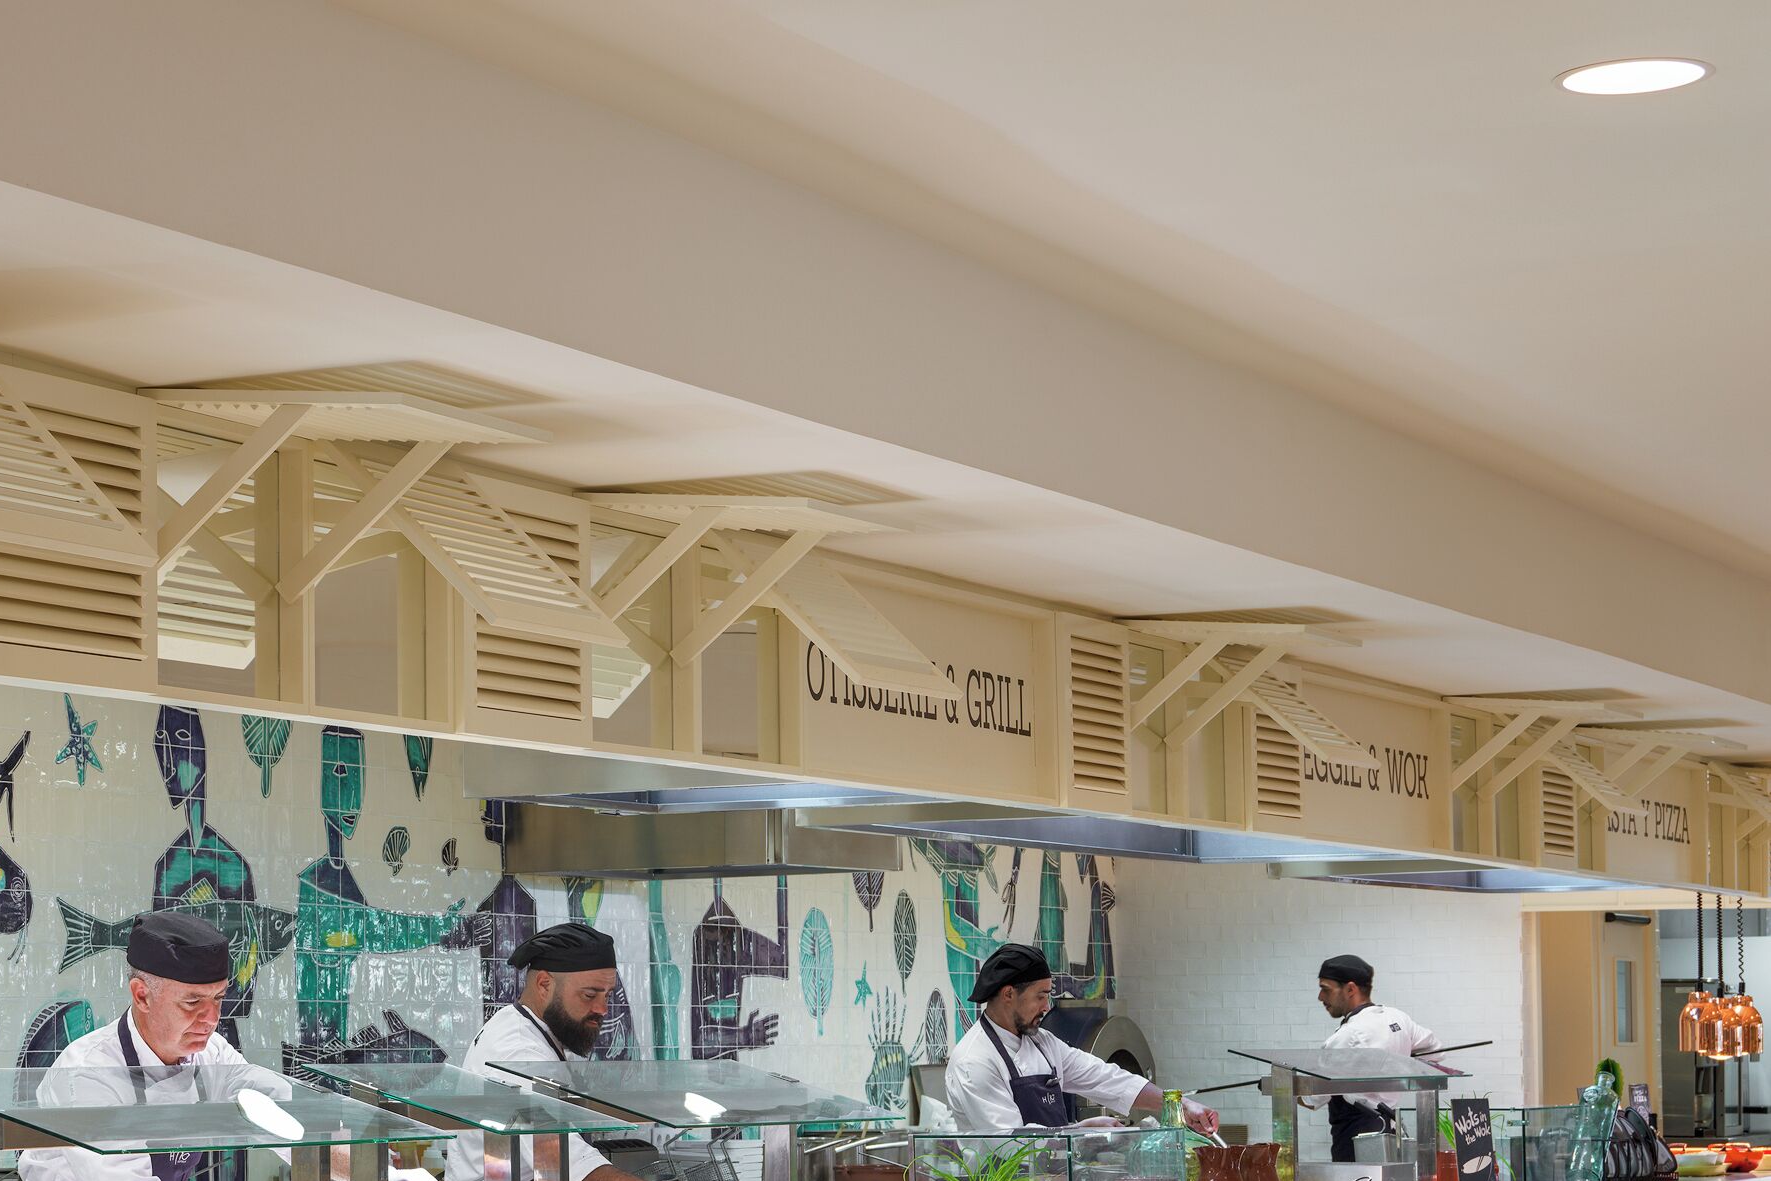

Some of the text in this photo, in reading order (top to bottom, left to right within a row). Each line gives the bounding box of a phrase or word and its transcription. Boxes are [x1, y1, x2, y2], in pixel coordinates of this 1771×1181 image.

[966, 668, 1032, 737] GRILL
[1385, 747, 1429, 799] WOK
[1654, 802, 1690, 844] PIZZA
[1455, 1106, 1487, 1135] Wots in
[1465, 1122, 1491, 1145] the Wok
